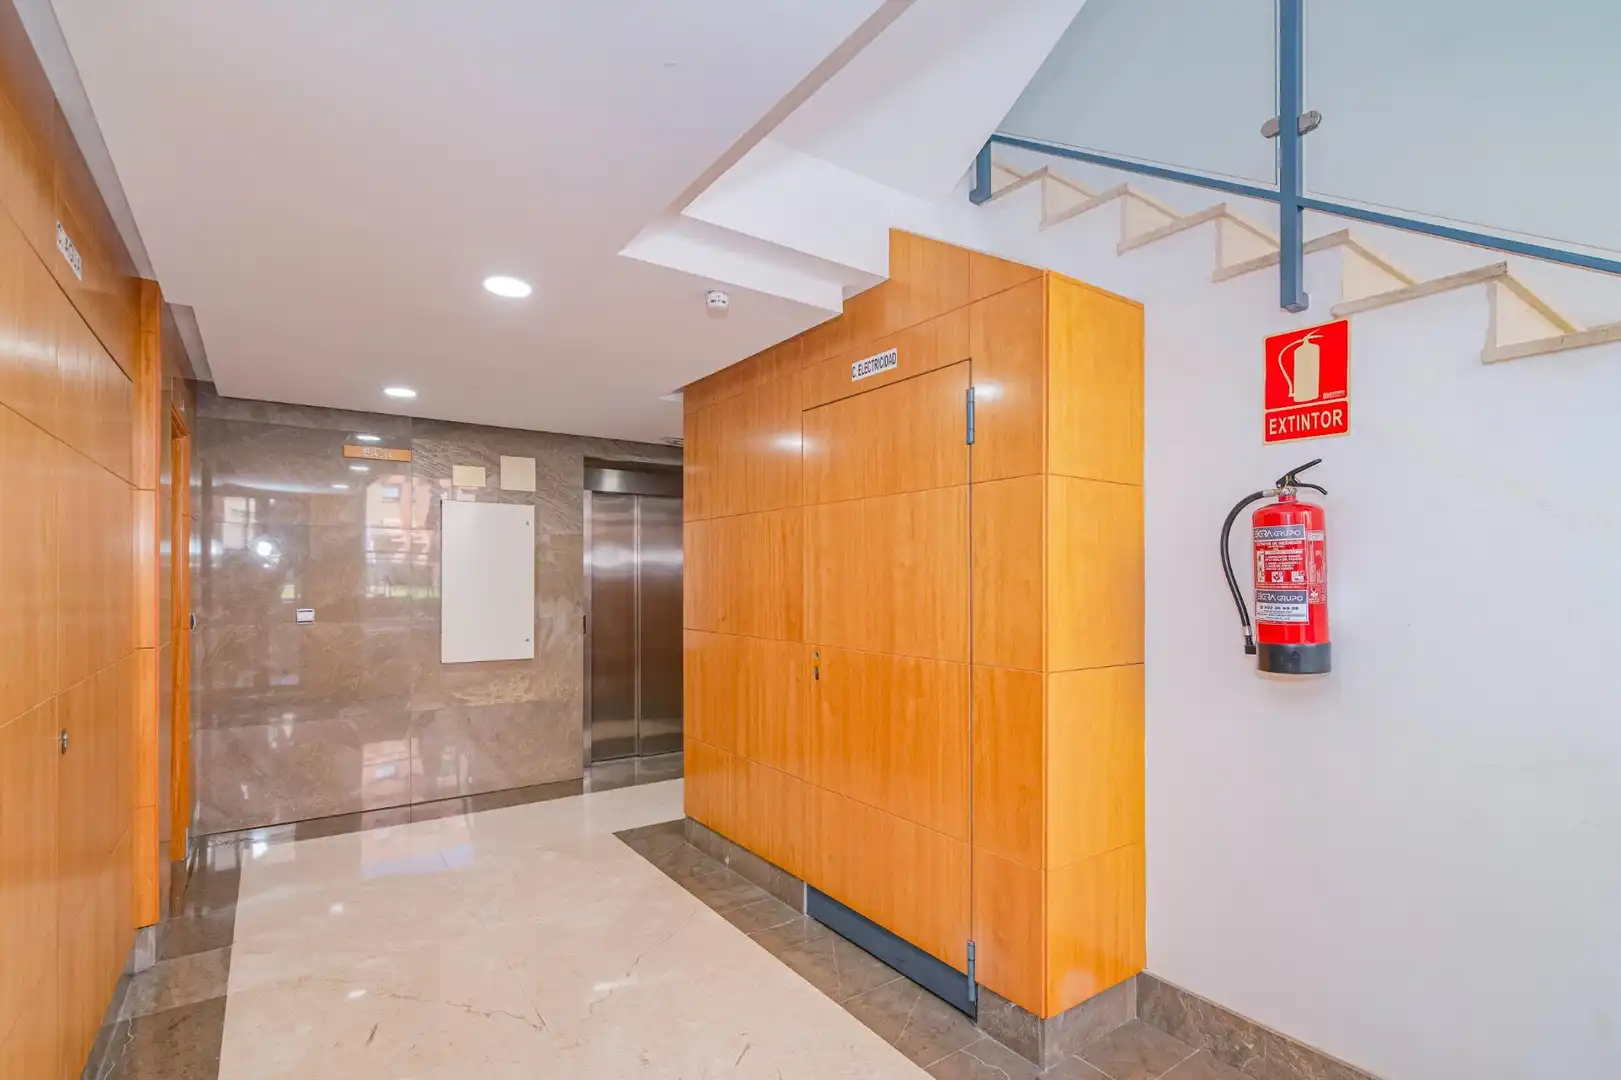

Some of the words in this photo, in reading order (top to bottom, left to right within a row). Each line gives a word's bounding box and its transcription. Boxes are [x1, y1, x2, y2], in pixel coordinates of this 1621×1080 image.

[858, 352, 896, 376] ELECTRICIDAD
[1269, 409, 1343, 435] EXTINTOR
[1273, 529, 1301, 537] GRUPO
